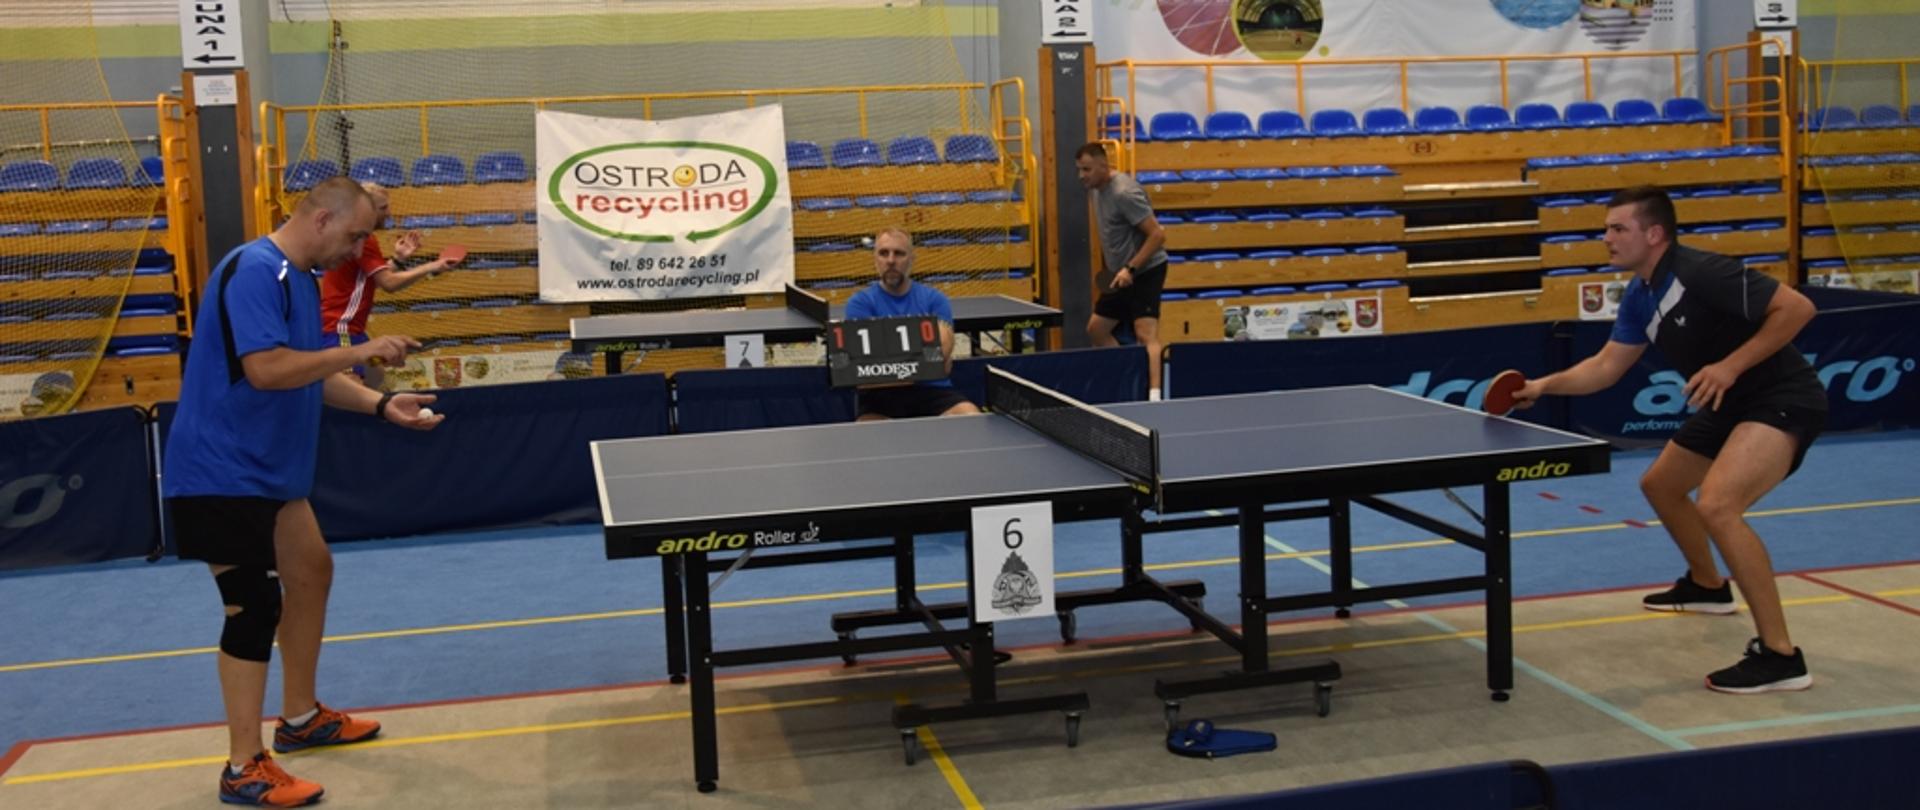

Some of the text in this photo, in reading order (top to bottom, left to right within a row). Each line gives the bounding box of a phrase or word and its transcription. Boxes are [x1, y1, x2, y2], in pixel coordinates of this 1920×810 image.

[204, 40, 218, 51] 1
[576, 188, 748, 219] recycling
[610, 253, 727, 272] tel. 89 642 26 51
[577, 269, 760, 289] www.ostrodarecycling.pl
[833, 320, 935, 355] 1 1 1 0
[739, 341, 749, 356] 7
[1496, 460, 1570, 481] andro
[656, 530, 795, 554] andro Roller
[1002, 517, 1024, 549] 6
